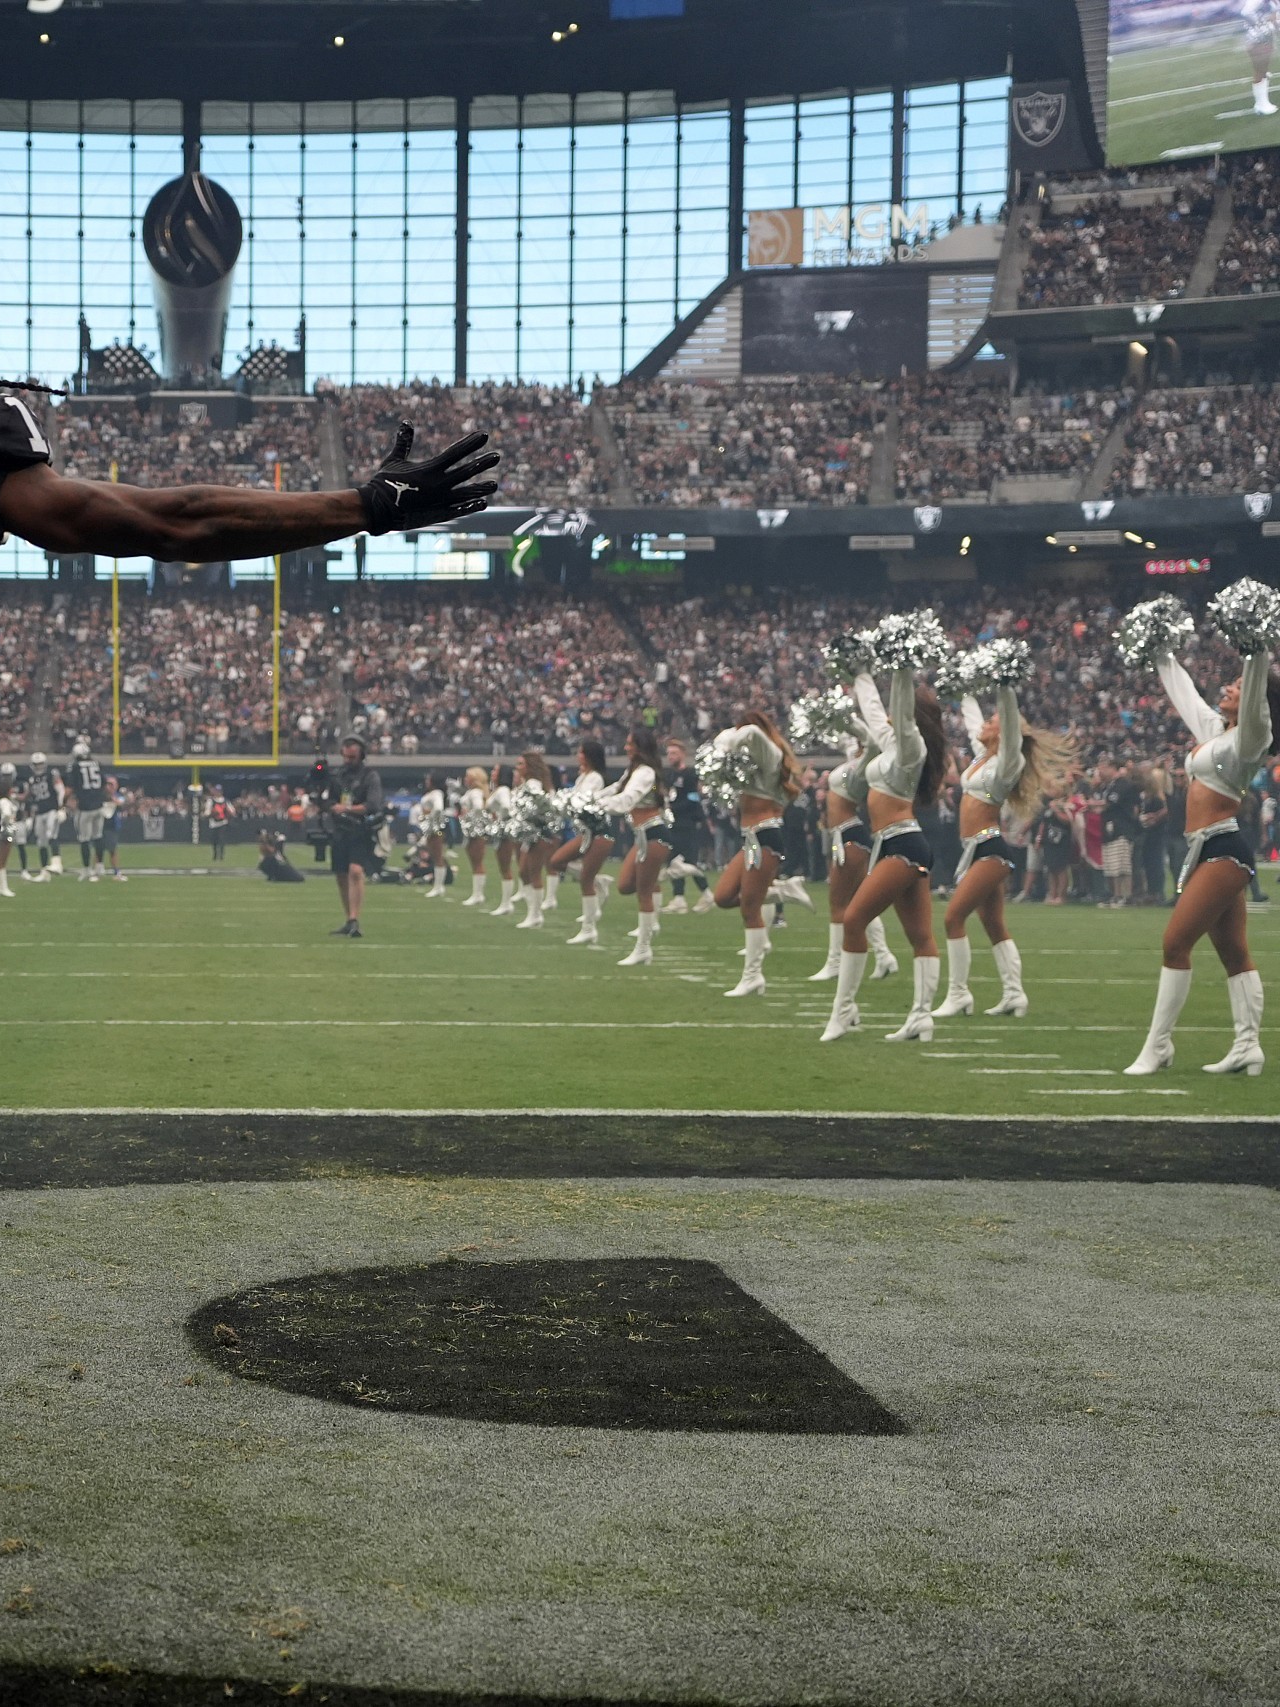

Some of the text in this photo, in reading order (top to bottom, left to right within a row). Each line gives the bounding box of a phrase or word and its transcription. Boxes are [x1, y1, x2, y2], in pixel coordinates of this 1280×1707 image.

[813, 204, 929, 240] MGM
[813, 244, 929, 264] REWARDS
[80, 767, 102, 790] 15
